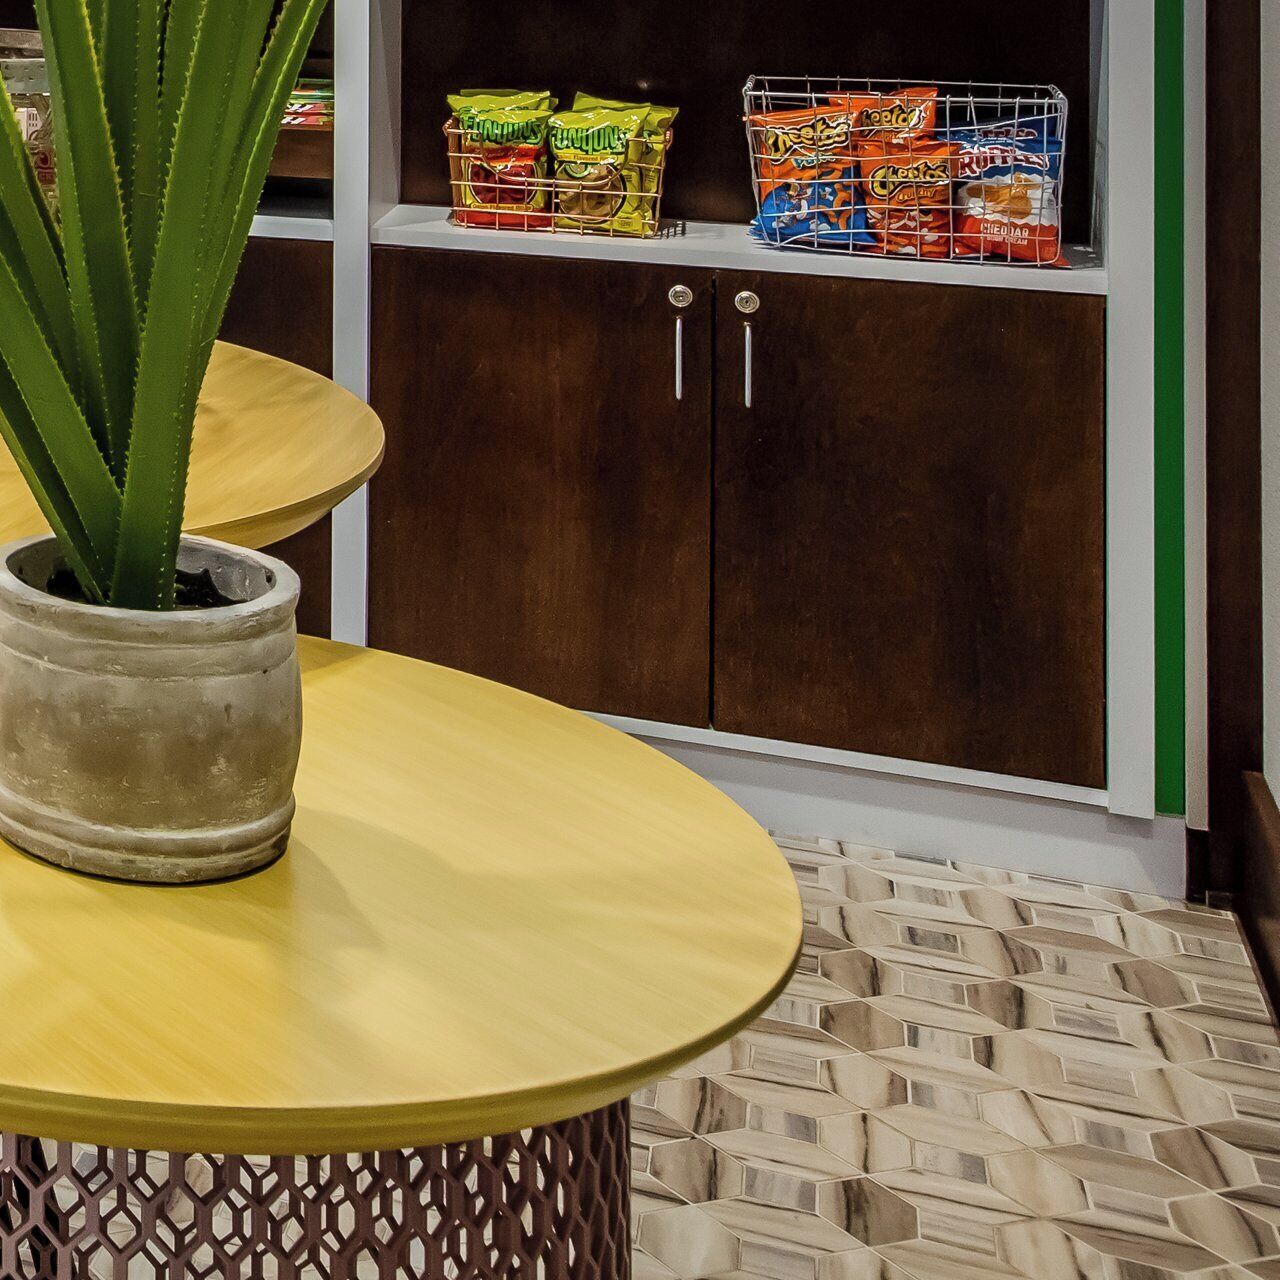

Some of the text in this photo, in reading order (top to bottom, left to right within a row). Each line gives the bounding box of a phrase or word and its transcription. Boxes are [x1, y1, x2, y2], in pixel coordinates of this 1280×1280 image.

[959, 144, 1051, 178] RUFFLES
[868, 163, 952, 201] Cheetos
[980, 222, 1030, 238] CHEDDAR
[1005, 235, 1029, 246] CREAM
